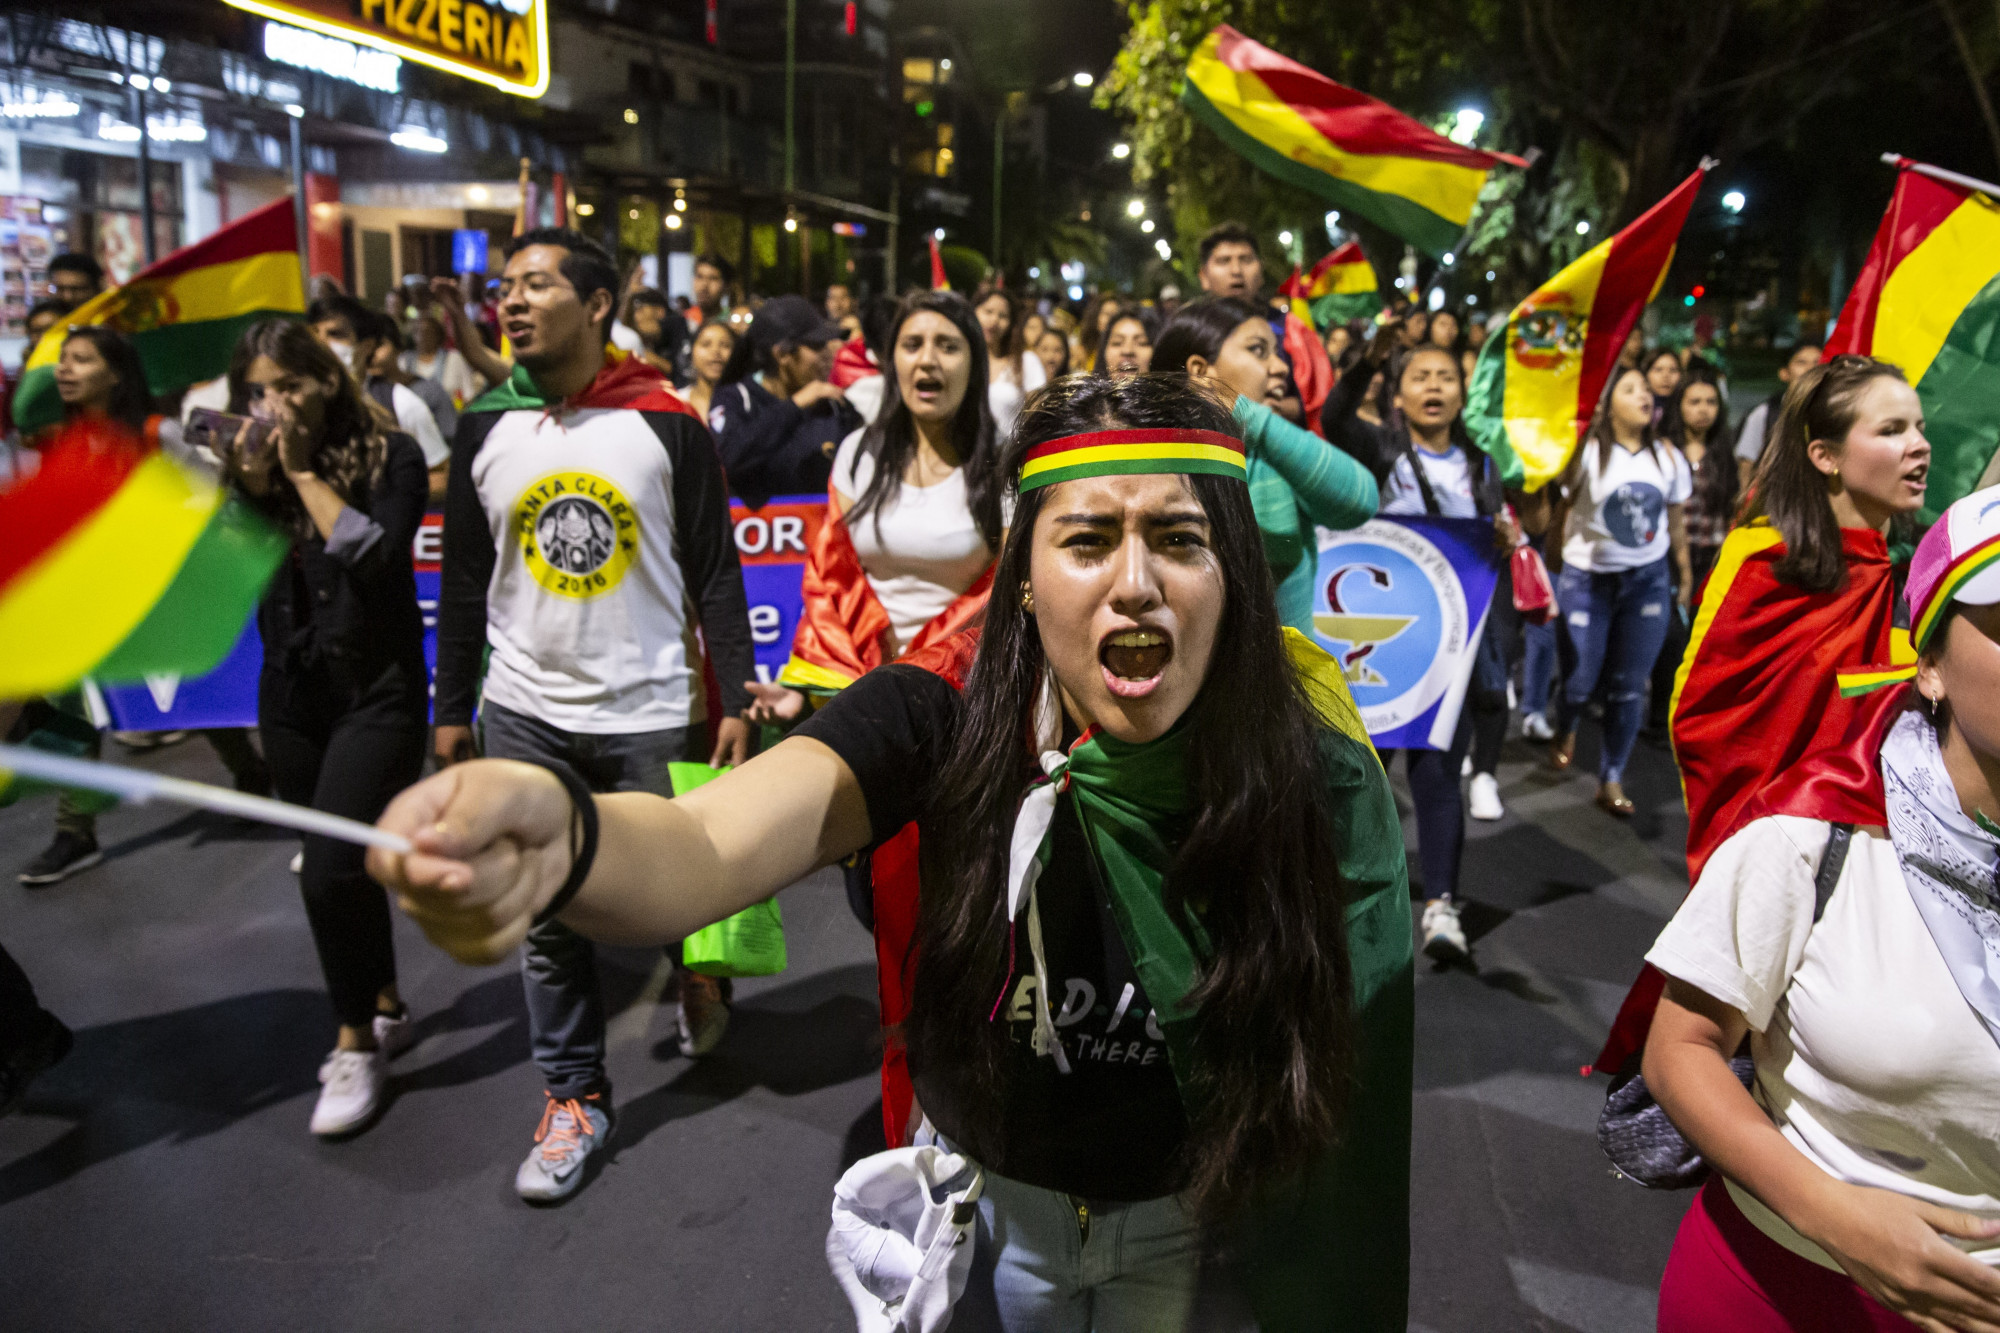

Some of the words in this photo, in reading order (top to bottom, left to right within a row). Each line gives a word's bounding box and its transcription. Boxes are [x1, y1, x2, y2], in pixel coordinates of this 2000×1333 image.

[574, 477, 633, 530] CLARA
[556, 571, 607, 592] 2016
[1077, 1033, 1159, 1065] THERE
